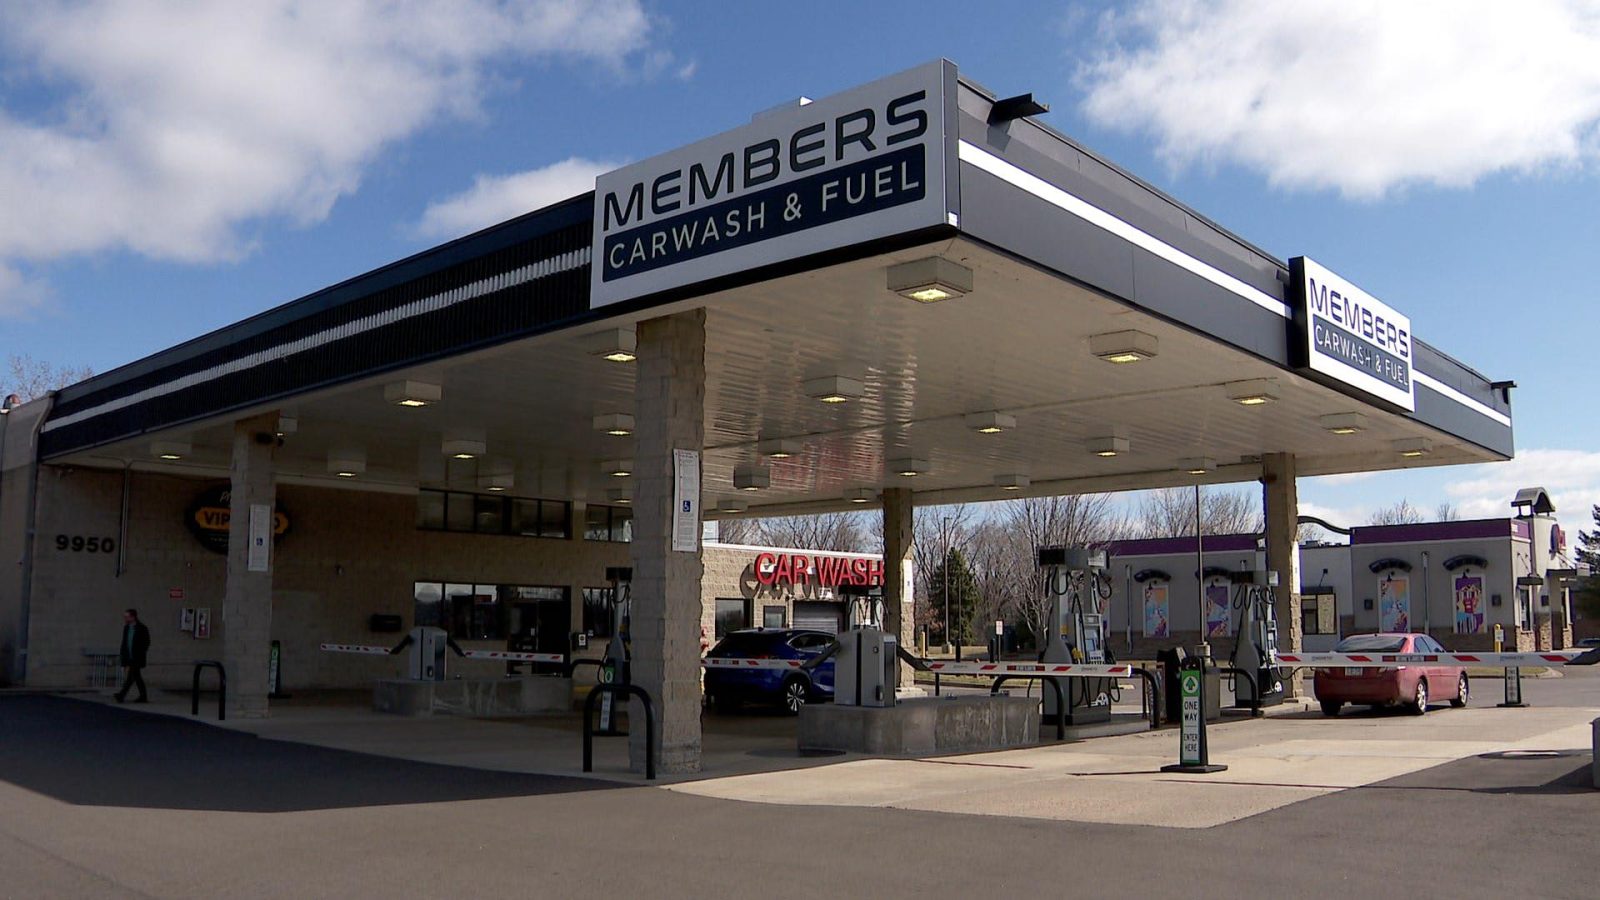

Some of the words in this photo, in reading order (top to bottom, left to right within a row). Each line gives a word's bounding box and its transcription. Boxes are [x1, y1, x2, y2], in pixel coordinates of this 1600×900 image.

[603, 90, 928, 231] MEMBERS
[609, 203, 766, 269] CARWASH
[783, 193, 802, 222] &
[822, 161, 919, 212] FUEL
[1310, 278, 1408, 357] MEMBERS
[1315, 325, 1372, 369] CARWASH
[1375, 354, 1382, 373] &
[1385, 359, 1409, 386] FUEL
[56, 534, 115, 553] 9950
[754, 552, 810, 586] CAR
[814, 556, 885, 587] WASH
[1184, 701, 1198, 710] ONE
[1184, 713, 1198, 721] WAY
[1184, 744, 1198, 752] HERE
